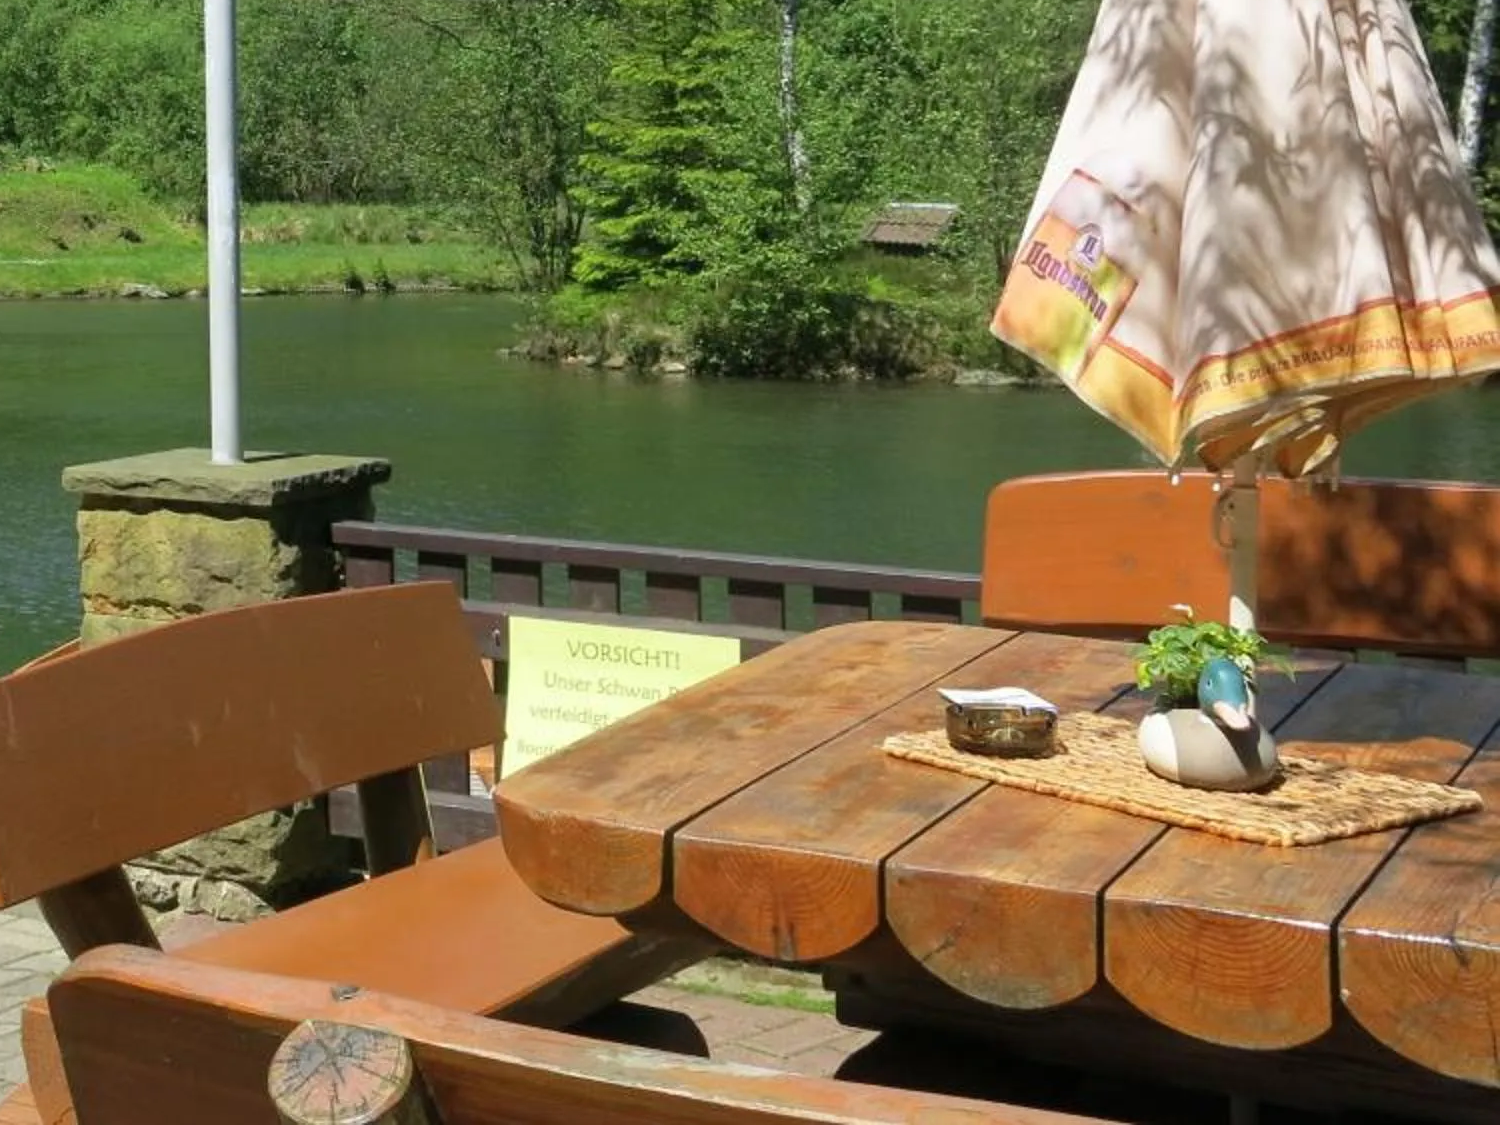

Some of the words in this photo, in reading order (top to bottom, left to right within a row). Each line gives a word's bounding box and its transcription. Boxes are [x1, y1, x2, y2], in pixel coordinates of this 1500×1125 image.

[566, 639, 681, 671] VORSICHT!
[543, 671, 593, 693] Unser
[597, 677, 661, 701] Schwan
